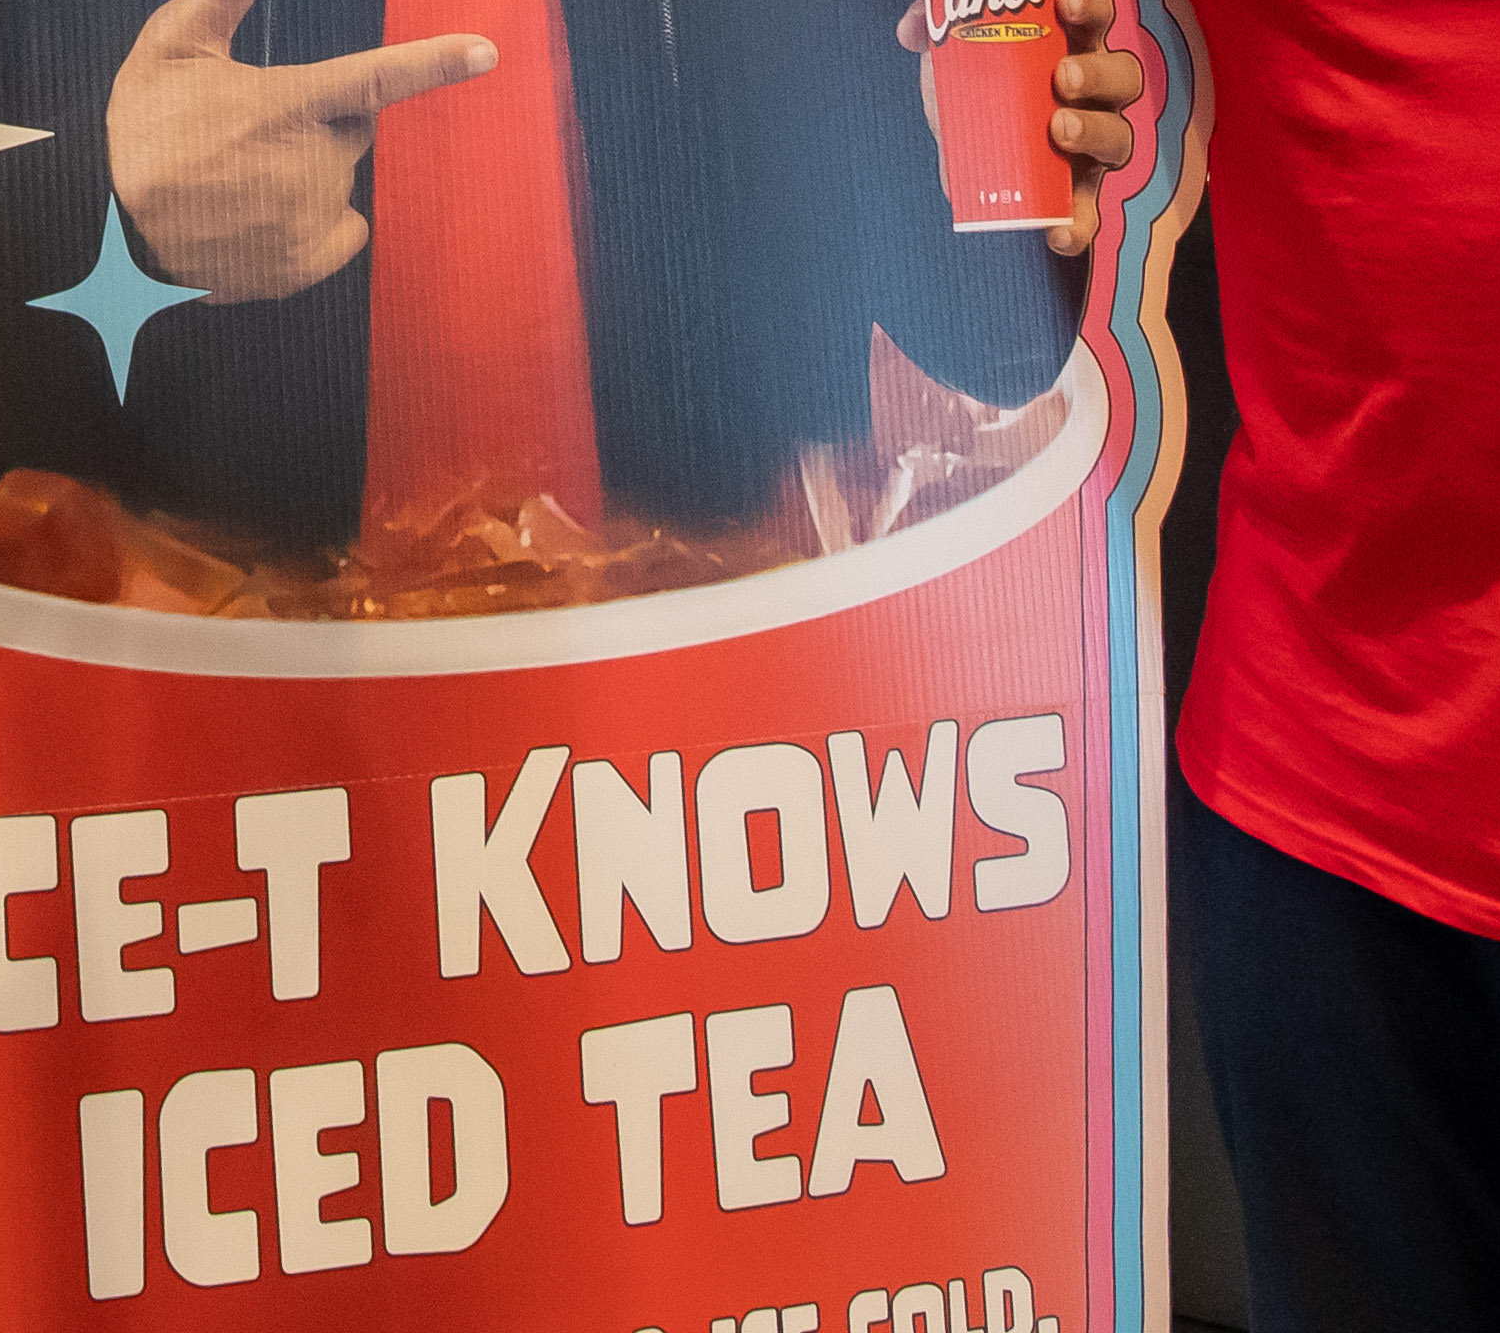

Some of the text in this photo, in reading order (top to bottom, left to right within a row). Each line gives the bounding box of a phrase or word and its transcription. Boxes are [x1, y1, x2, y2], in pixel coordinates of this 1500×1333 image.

[958, 25, 1045, 38] CHICKEN FINGERS
[429, 712, 1072, 981] KNOWS
[78, 983, 948, 1301] ICED TEA
